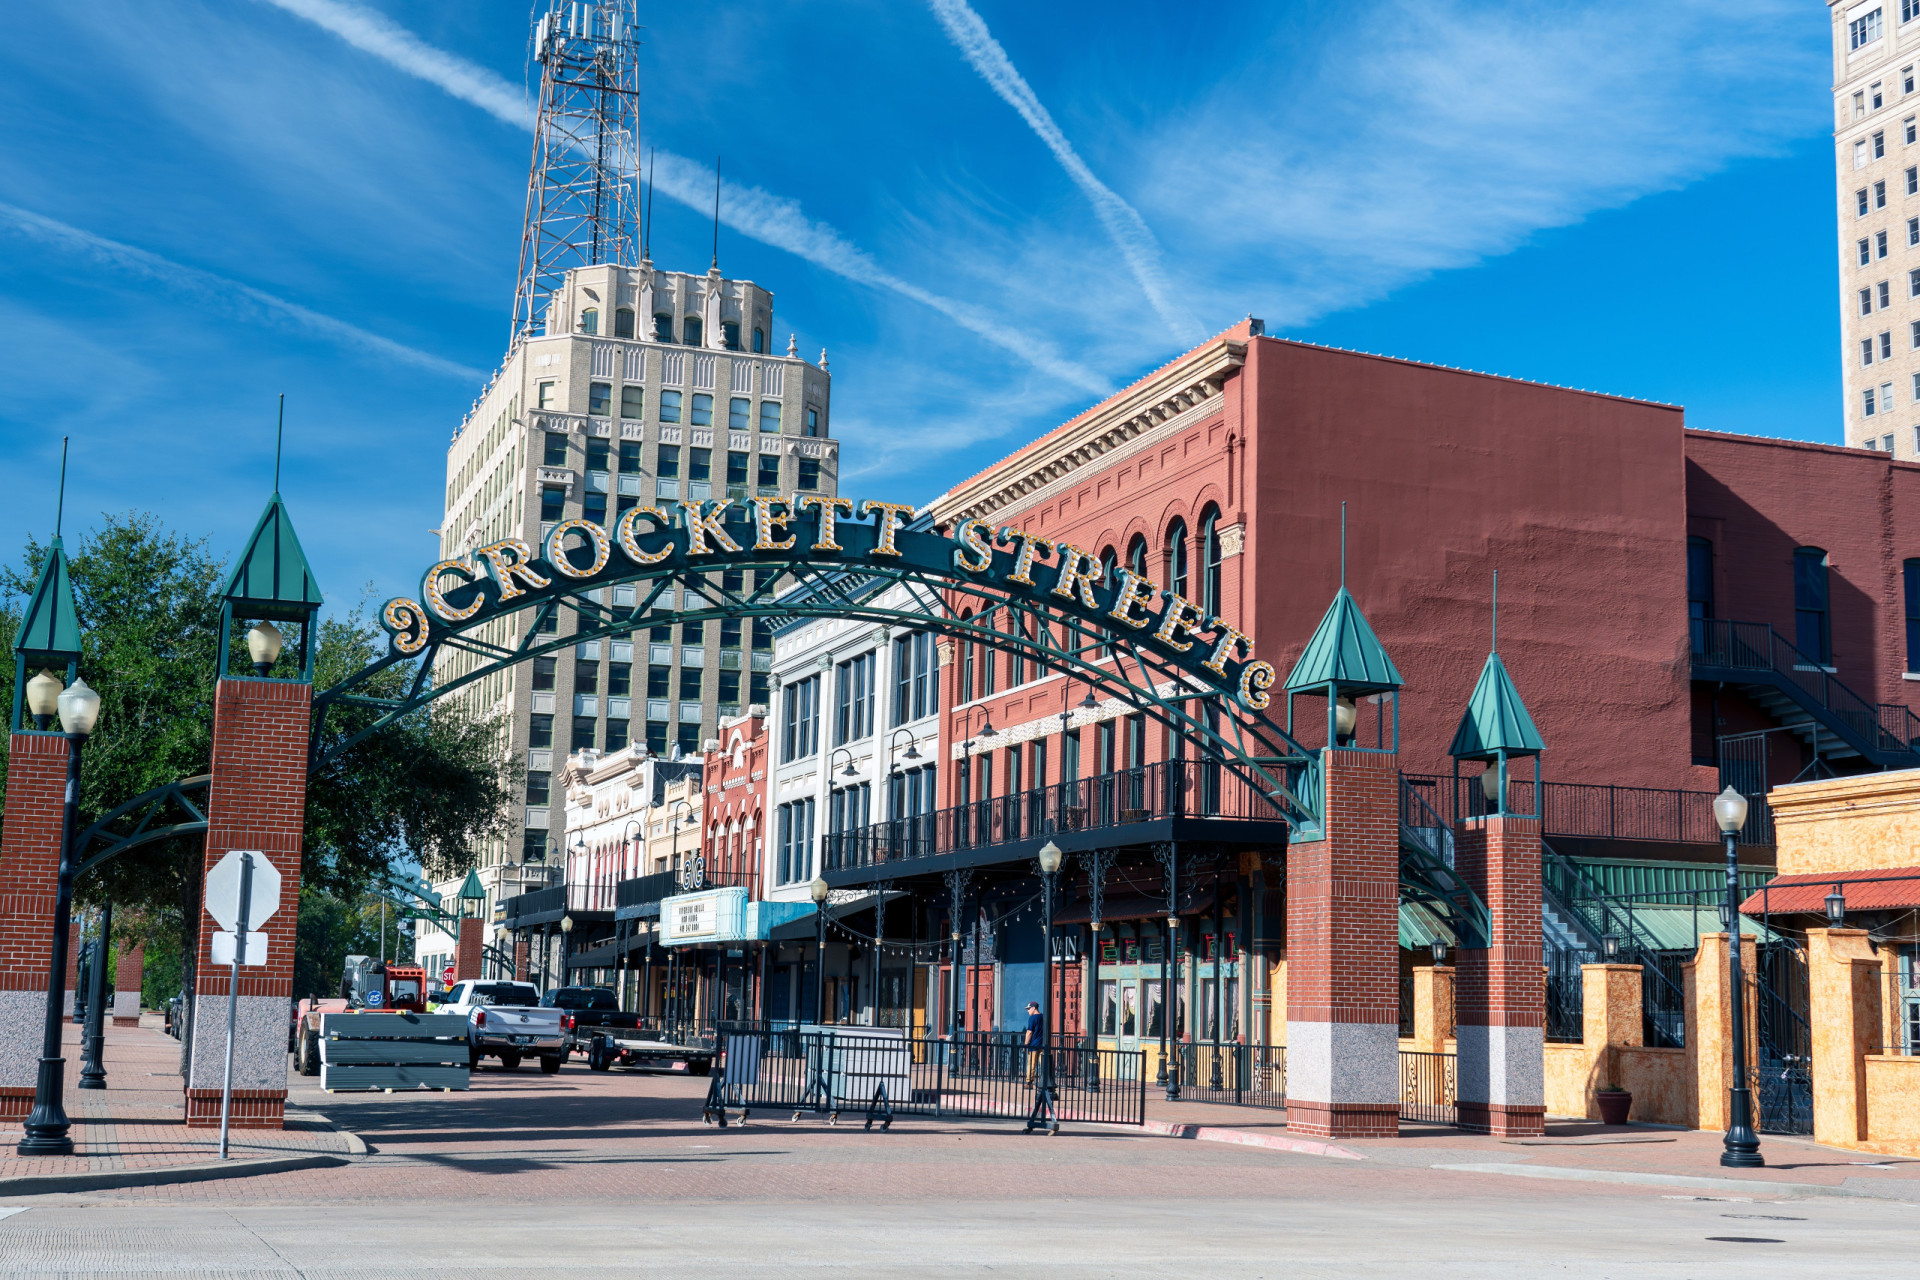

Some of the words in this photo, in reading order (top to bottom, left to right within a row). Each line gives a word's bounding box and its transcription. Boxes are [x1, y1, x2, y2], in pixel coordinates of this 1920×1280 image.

[420, 496, 915, 623] CROCKETT
[953, 517, 1256, 680] STREET
[683, 857, 704, 890] GIG
[443, 972, 455, 981] STO
